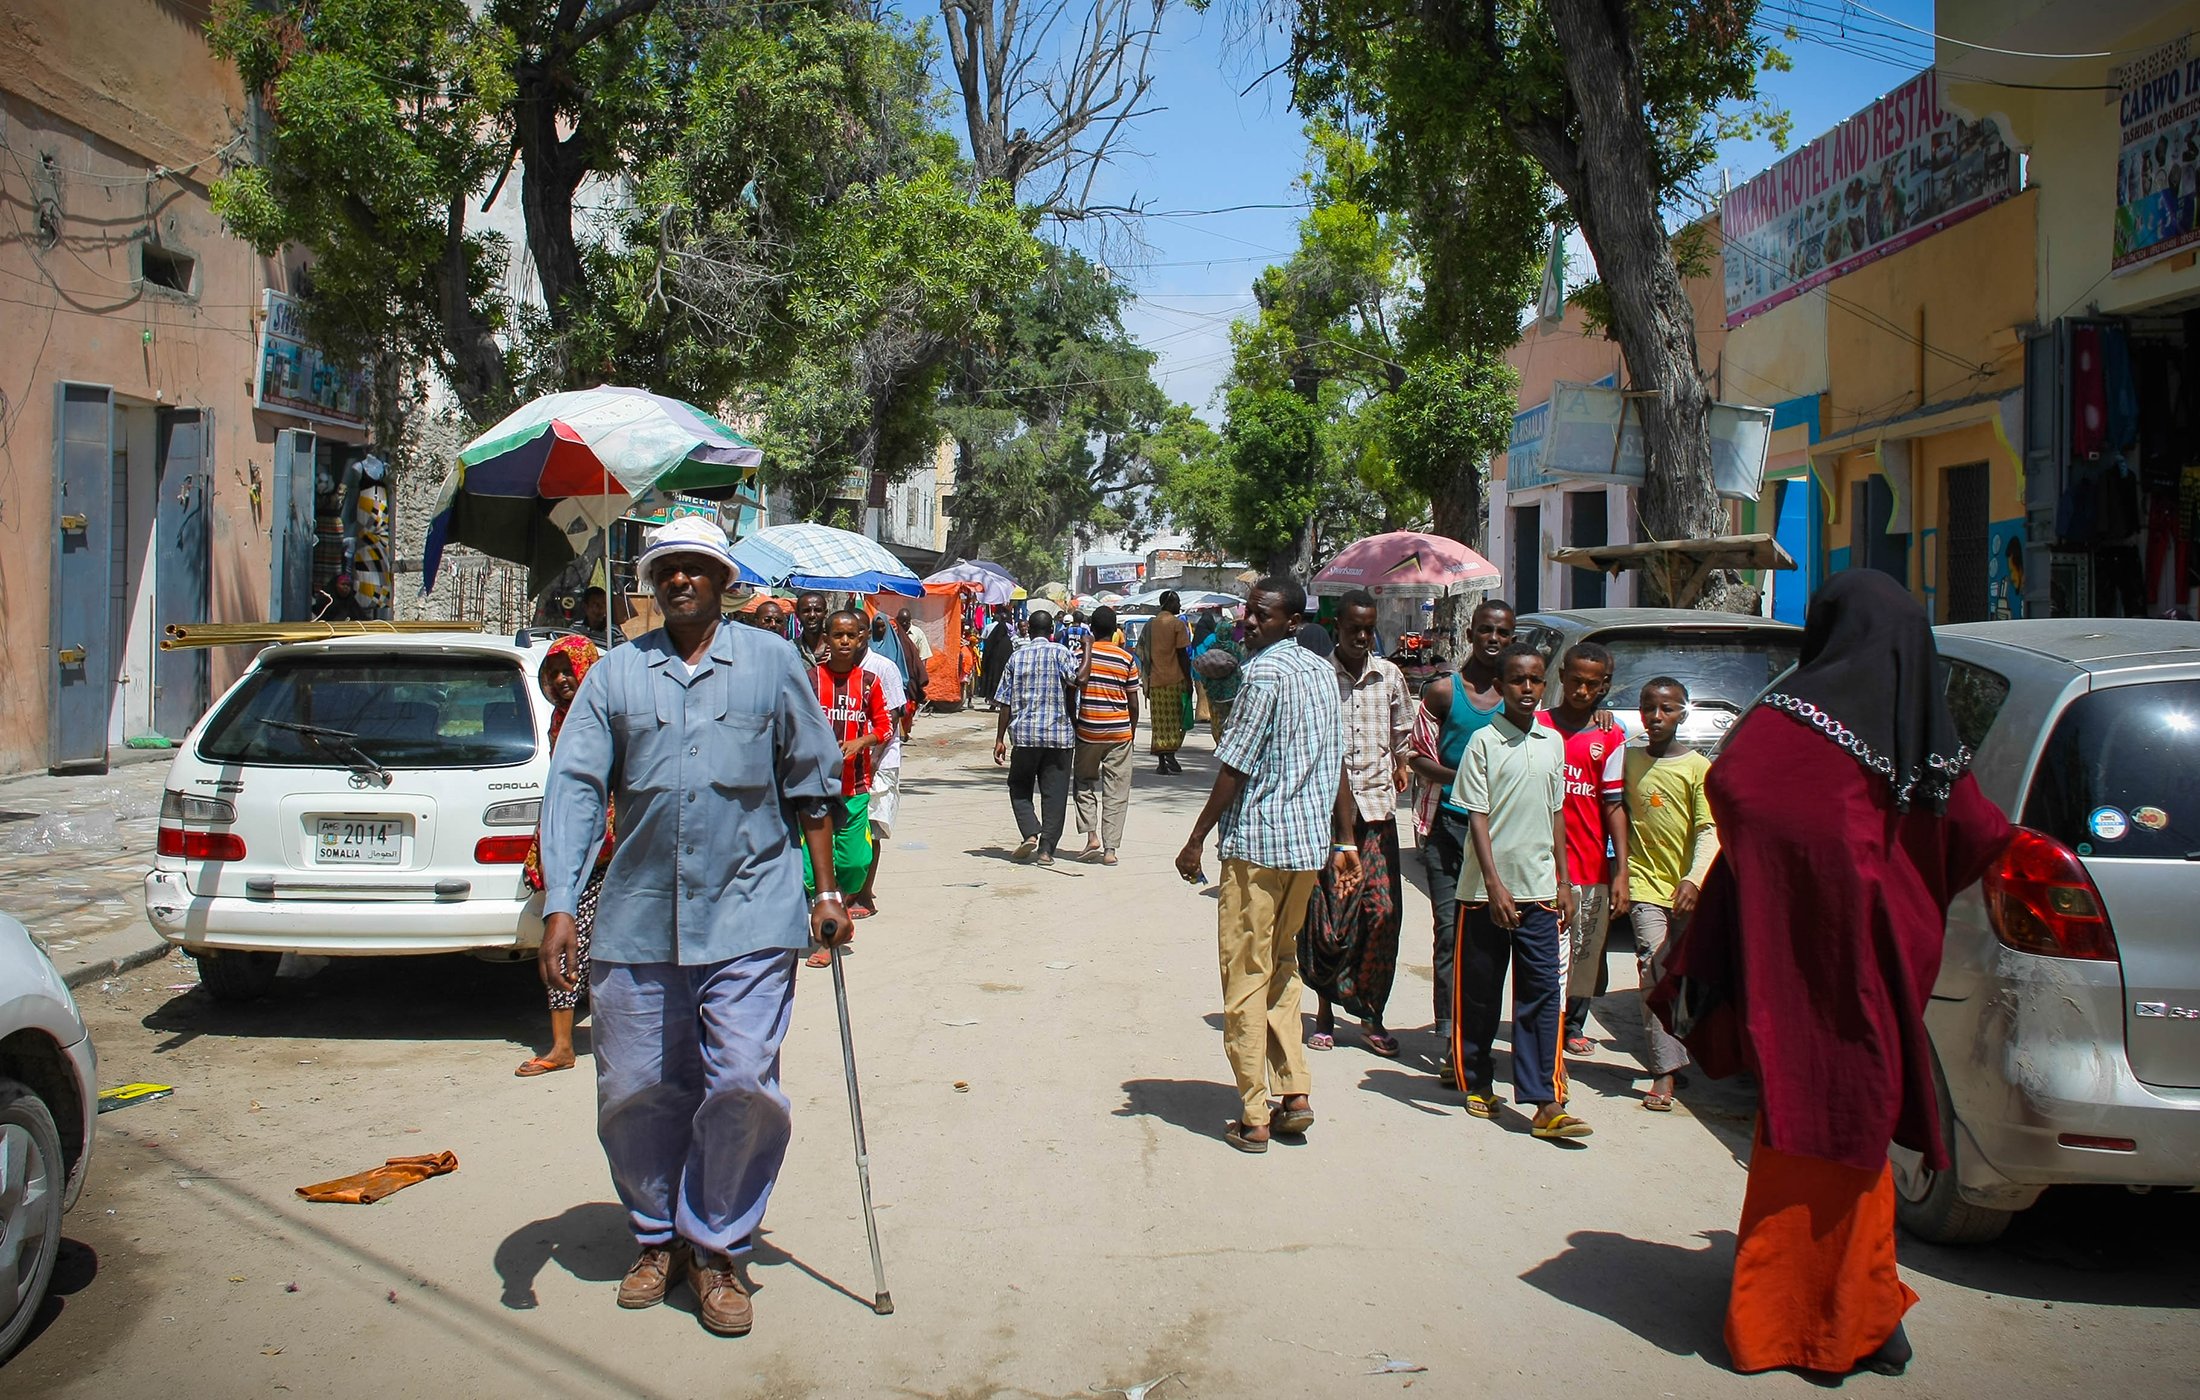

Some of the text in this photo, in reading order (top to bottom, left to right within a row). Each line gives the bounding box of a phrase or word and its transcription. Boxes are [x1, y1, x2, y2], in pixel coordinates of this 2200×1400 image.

[2120, 69, 2180, 127] CARWO
[1724, 72, 1949, 242] ANKARA HOTEL AND RESTAU
[1328, 566, 1364, 576] Sportsman
[838, 694, 856, 708] Fly
[488, 782, 540, 790] COROLLA
[344, 823, 387, 845] 2014
[320, 848, 361, 858] SOMALIA
[368, 850, 397, 859] الصومال
